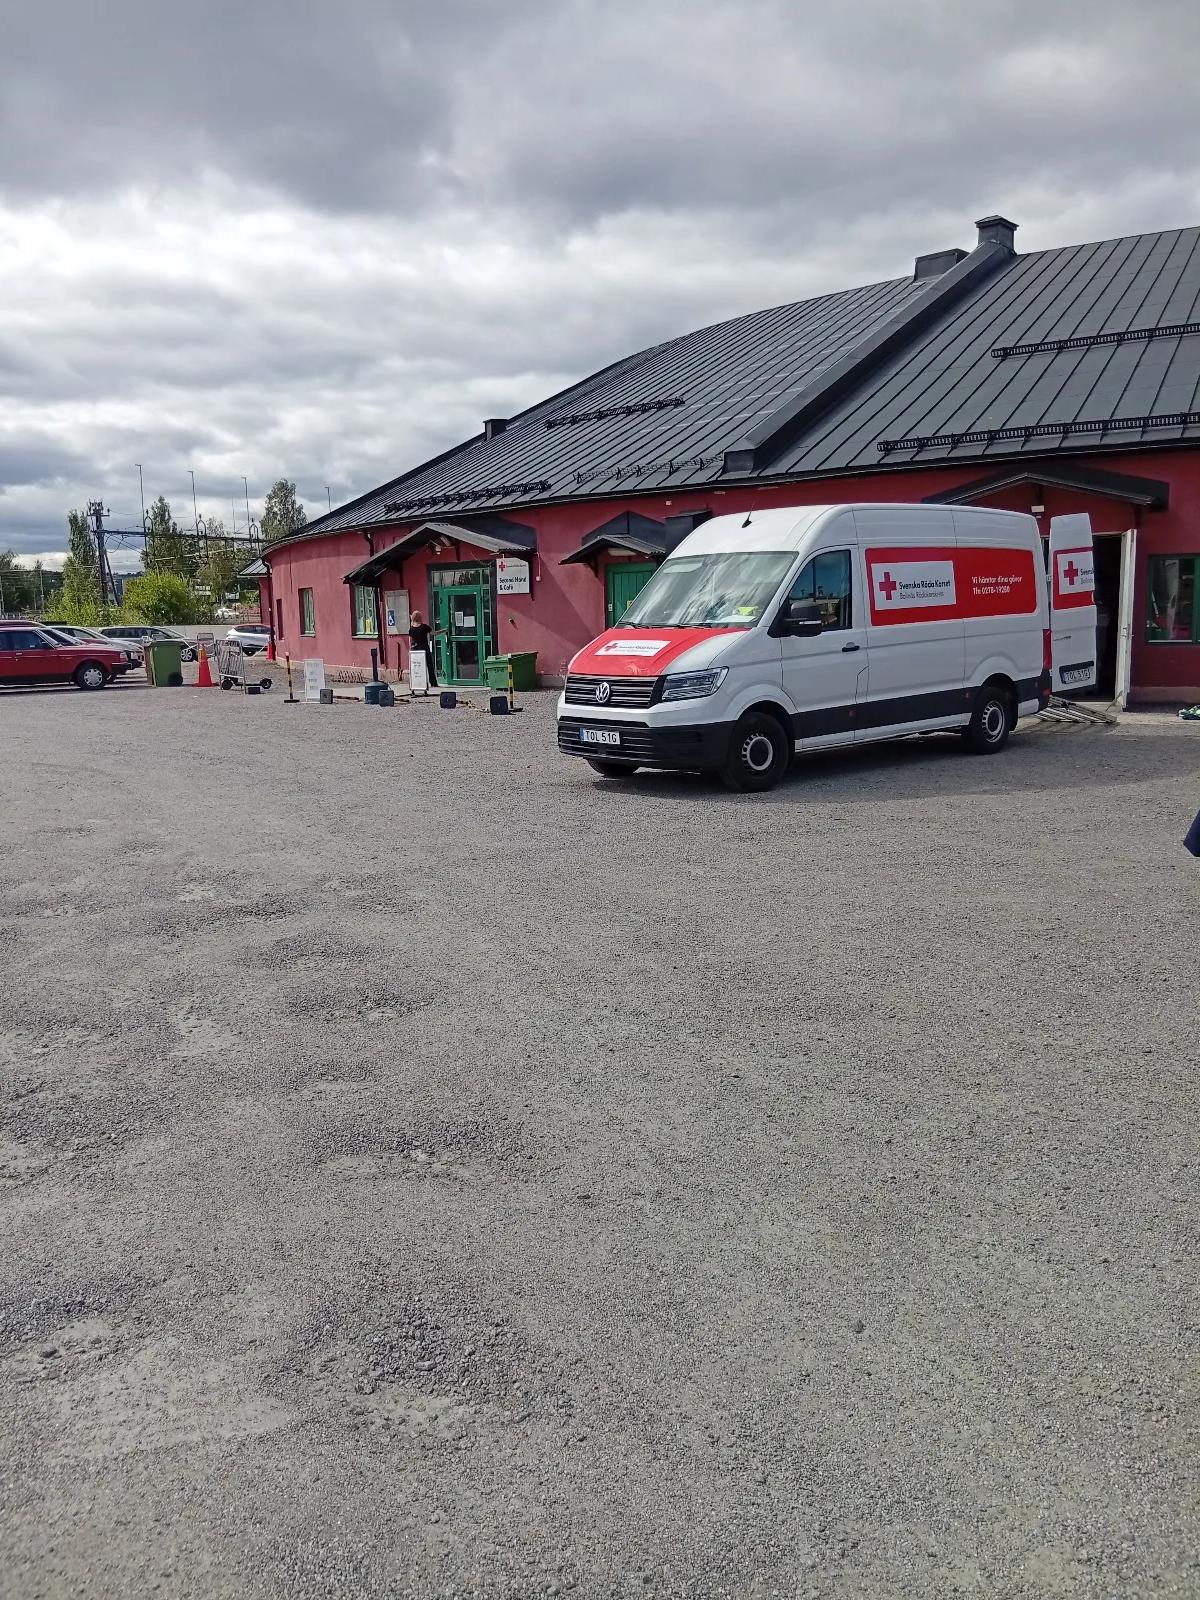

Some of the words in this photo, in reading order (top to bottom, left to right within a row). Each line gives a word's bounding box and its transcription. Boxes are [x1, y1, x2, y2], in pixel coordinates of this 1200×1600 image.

[978, 576, 997, 584] hämtar
[997, 575, 1009, 583] dina
[1009, 575, 1022, 584] gåvor
[899, 581, 920, 589] Svenska
[921, 580, 934, 588] Röda
[586, 731, 600, 741] TOL
[601, 732, 617, 743] 51G
